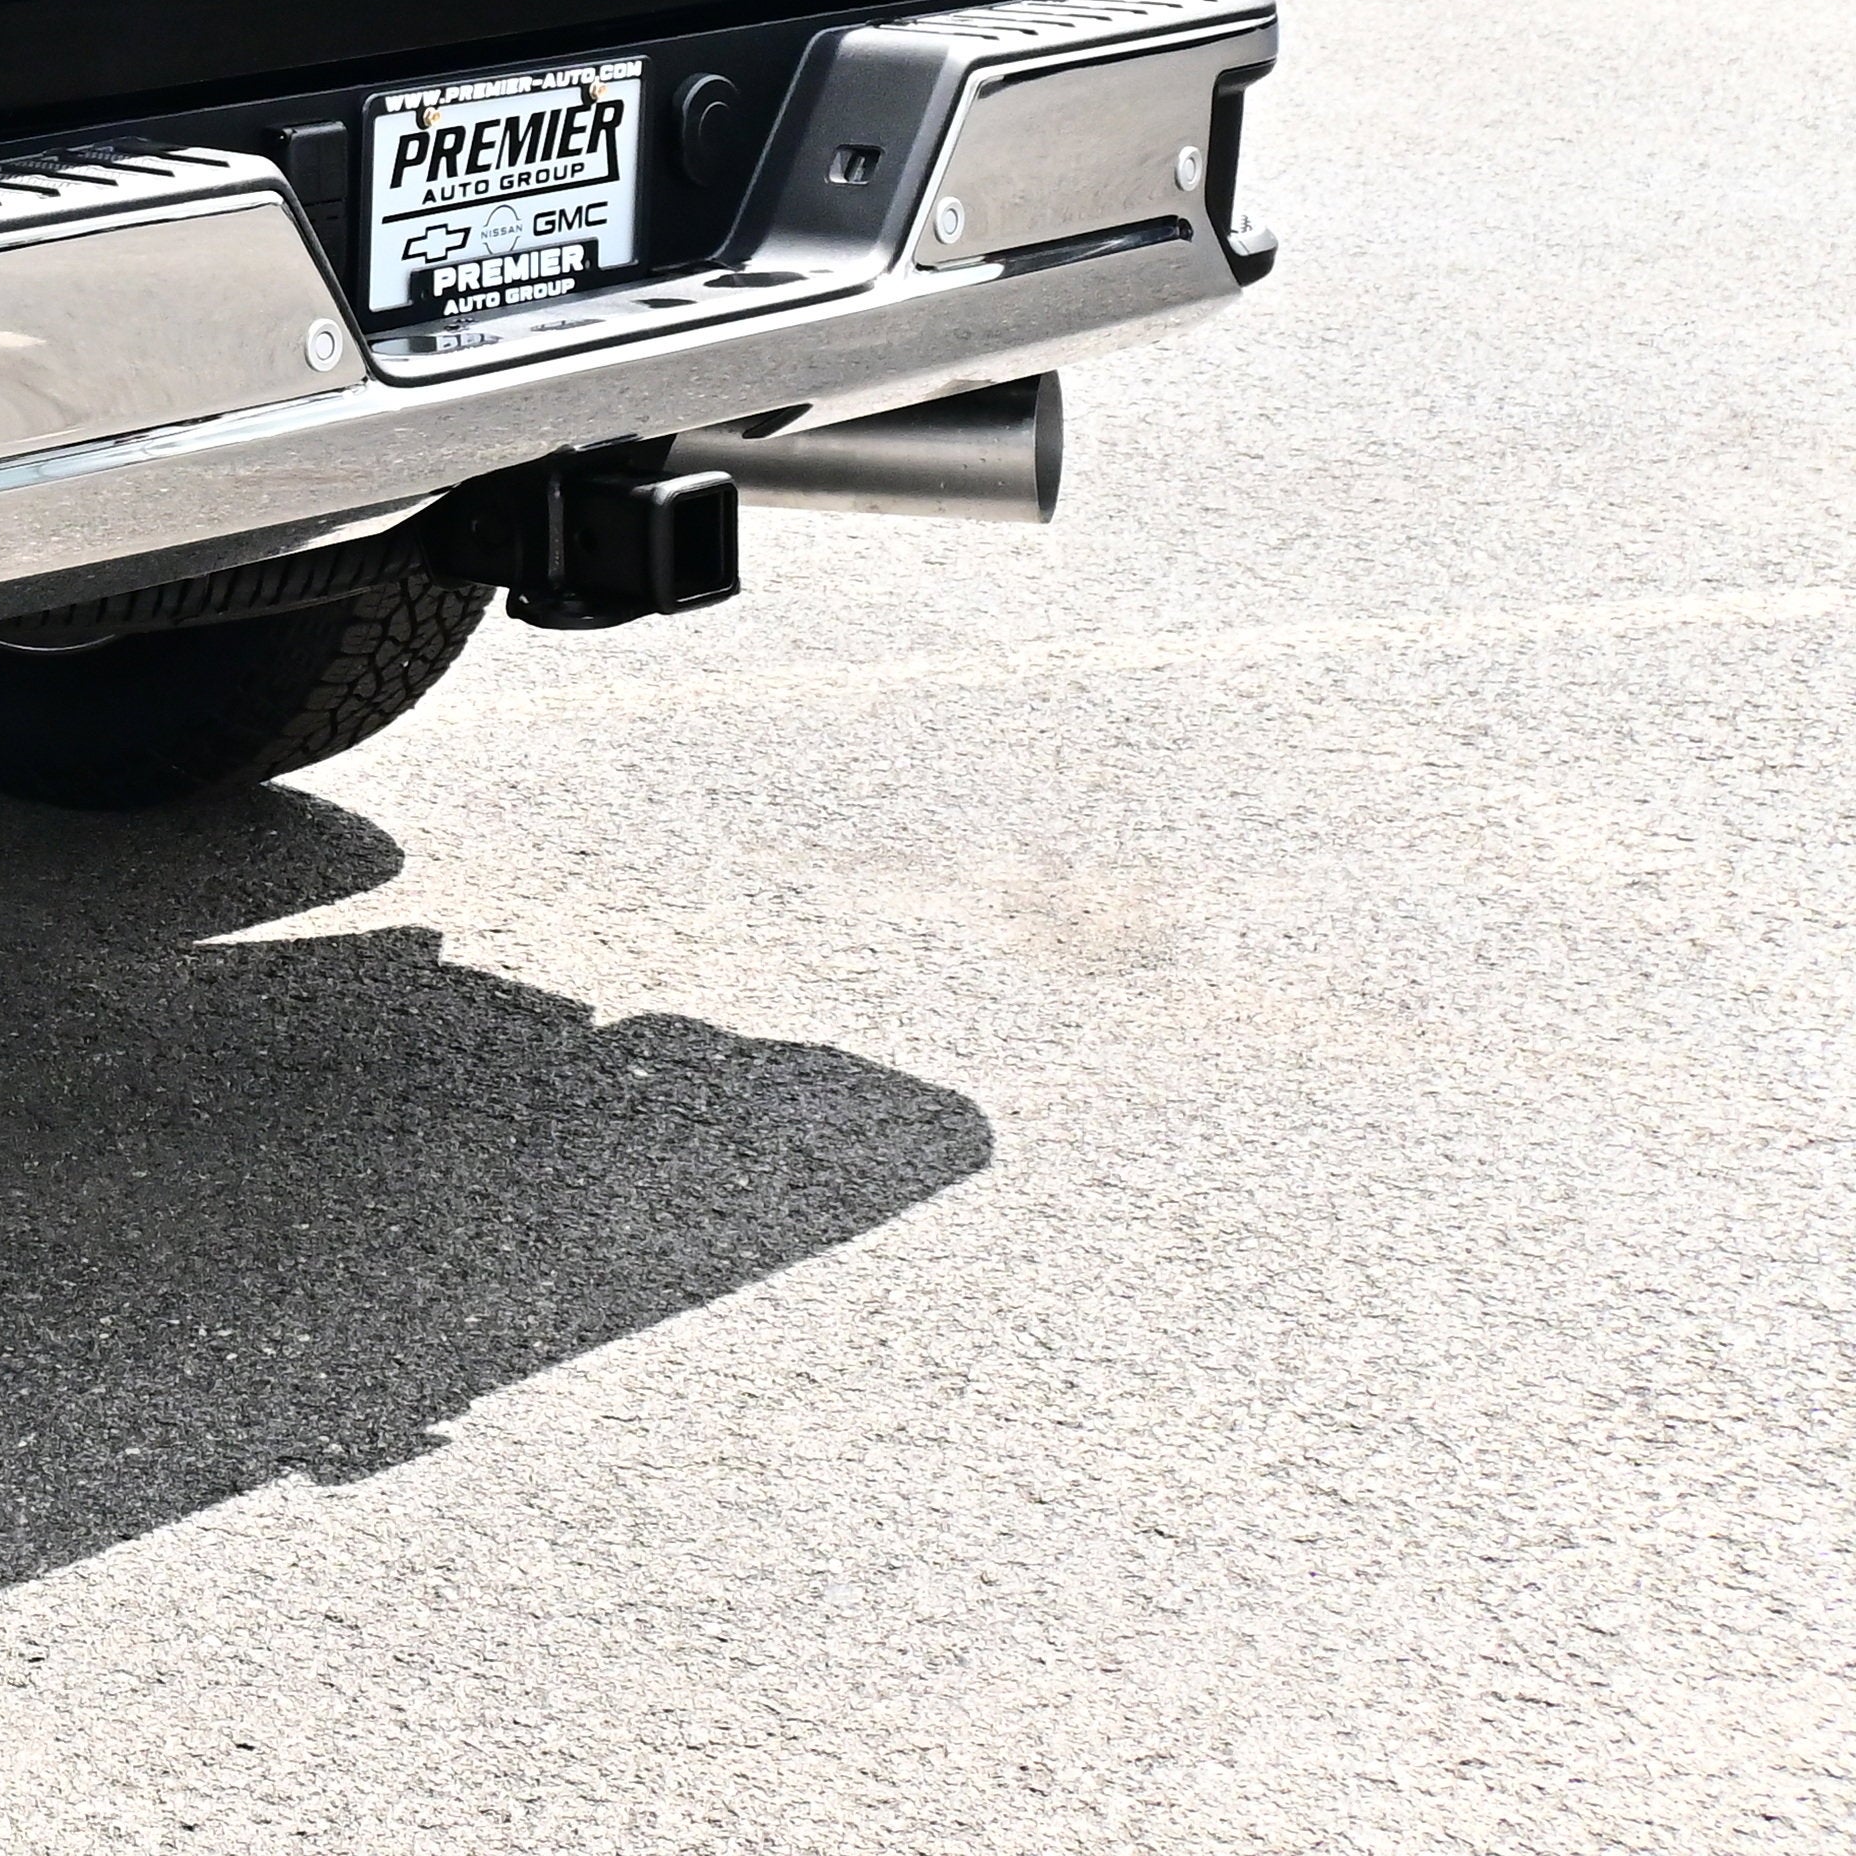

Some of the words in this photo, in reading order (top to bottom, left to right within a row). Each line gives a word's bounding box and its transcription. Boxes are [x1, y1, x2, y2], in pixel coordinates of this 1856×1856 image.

[384, 60, 643, 113] WWW.PREMIER-AUTO.COM
[389, 98, 626, 190] PREMIER
[421, 179, 490, 206] AUTO
[499, 162, 586, 190] GROUP
[480, 223, 524, 239] NISSAN
[532, 200, 609, 237] GMC
[432, 243, 586, 297] PREMIER
[443, 291, 500, 316] AUTO
[504, 278, 576, 304] GROUP
